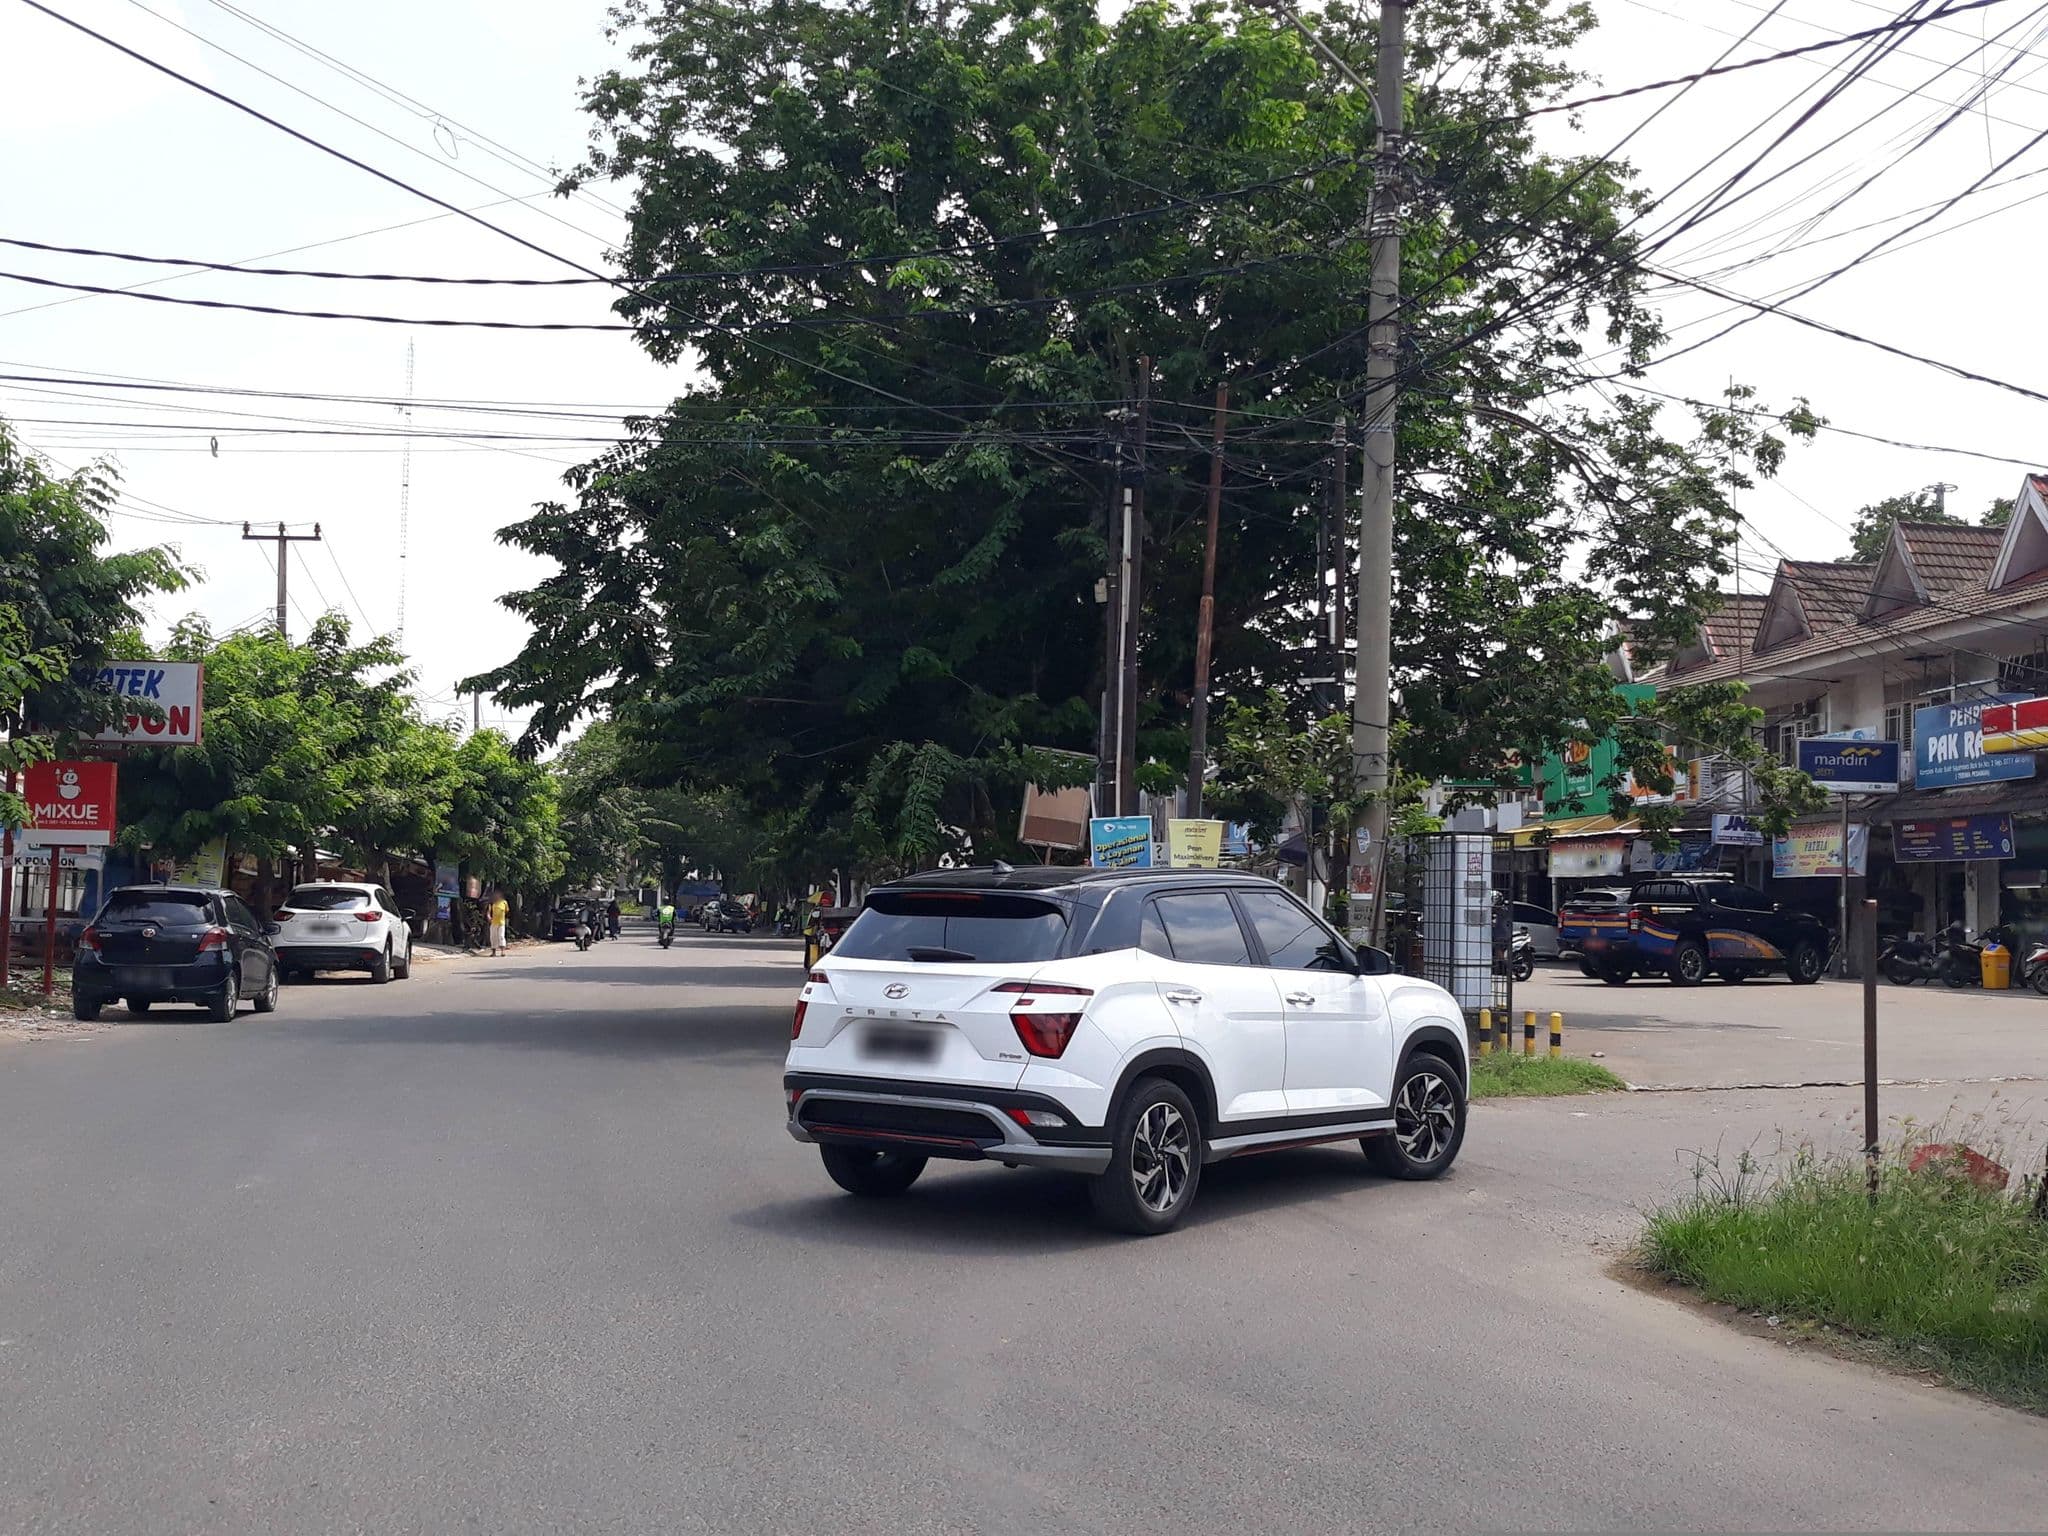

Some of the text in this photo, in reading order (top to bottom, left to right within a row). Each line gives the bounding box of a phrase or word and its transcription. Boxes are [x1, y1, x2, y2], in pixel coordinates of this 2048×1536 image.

[1928, 730, 1985, 763] PAK RA
[1814, 753, 1868, 766] mandiri
[34, 803, 99, 820] MIXUE
[1095, 833, 1148, 852] Operasional
[1107, 844, 1145, 859] Layanan
[25, 856, 76, 867] POLYON
[845, 1007, 946, 1020] CRETA
